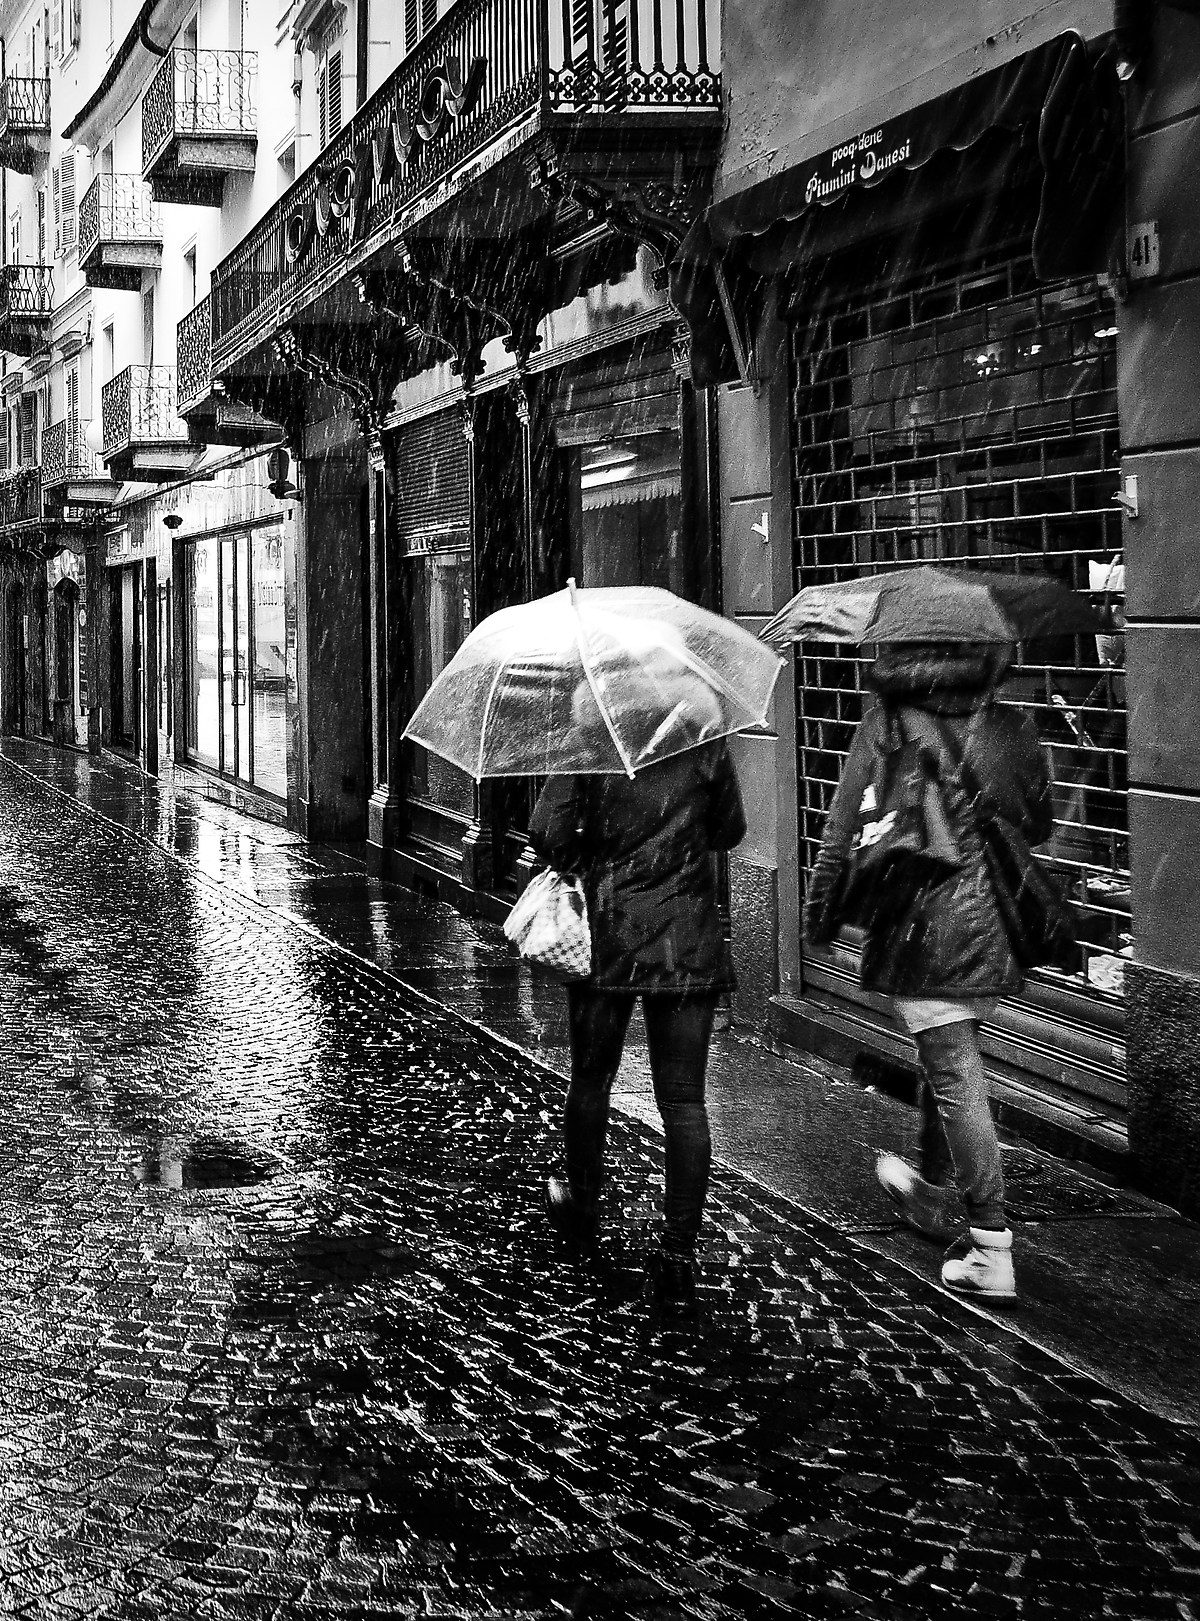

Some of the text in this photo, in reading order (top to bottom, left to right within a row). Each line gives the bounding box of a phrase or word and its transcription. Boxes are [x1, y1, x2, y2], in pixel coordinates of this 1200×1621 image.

[805, 138, 910, 204] Piumini Danesi
[1132, 235, 1150, 266] 41
